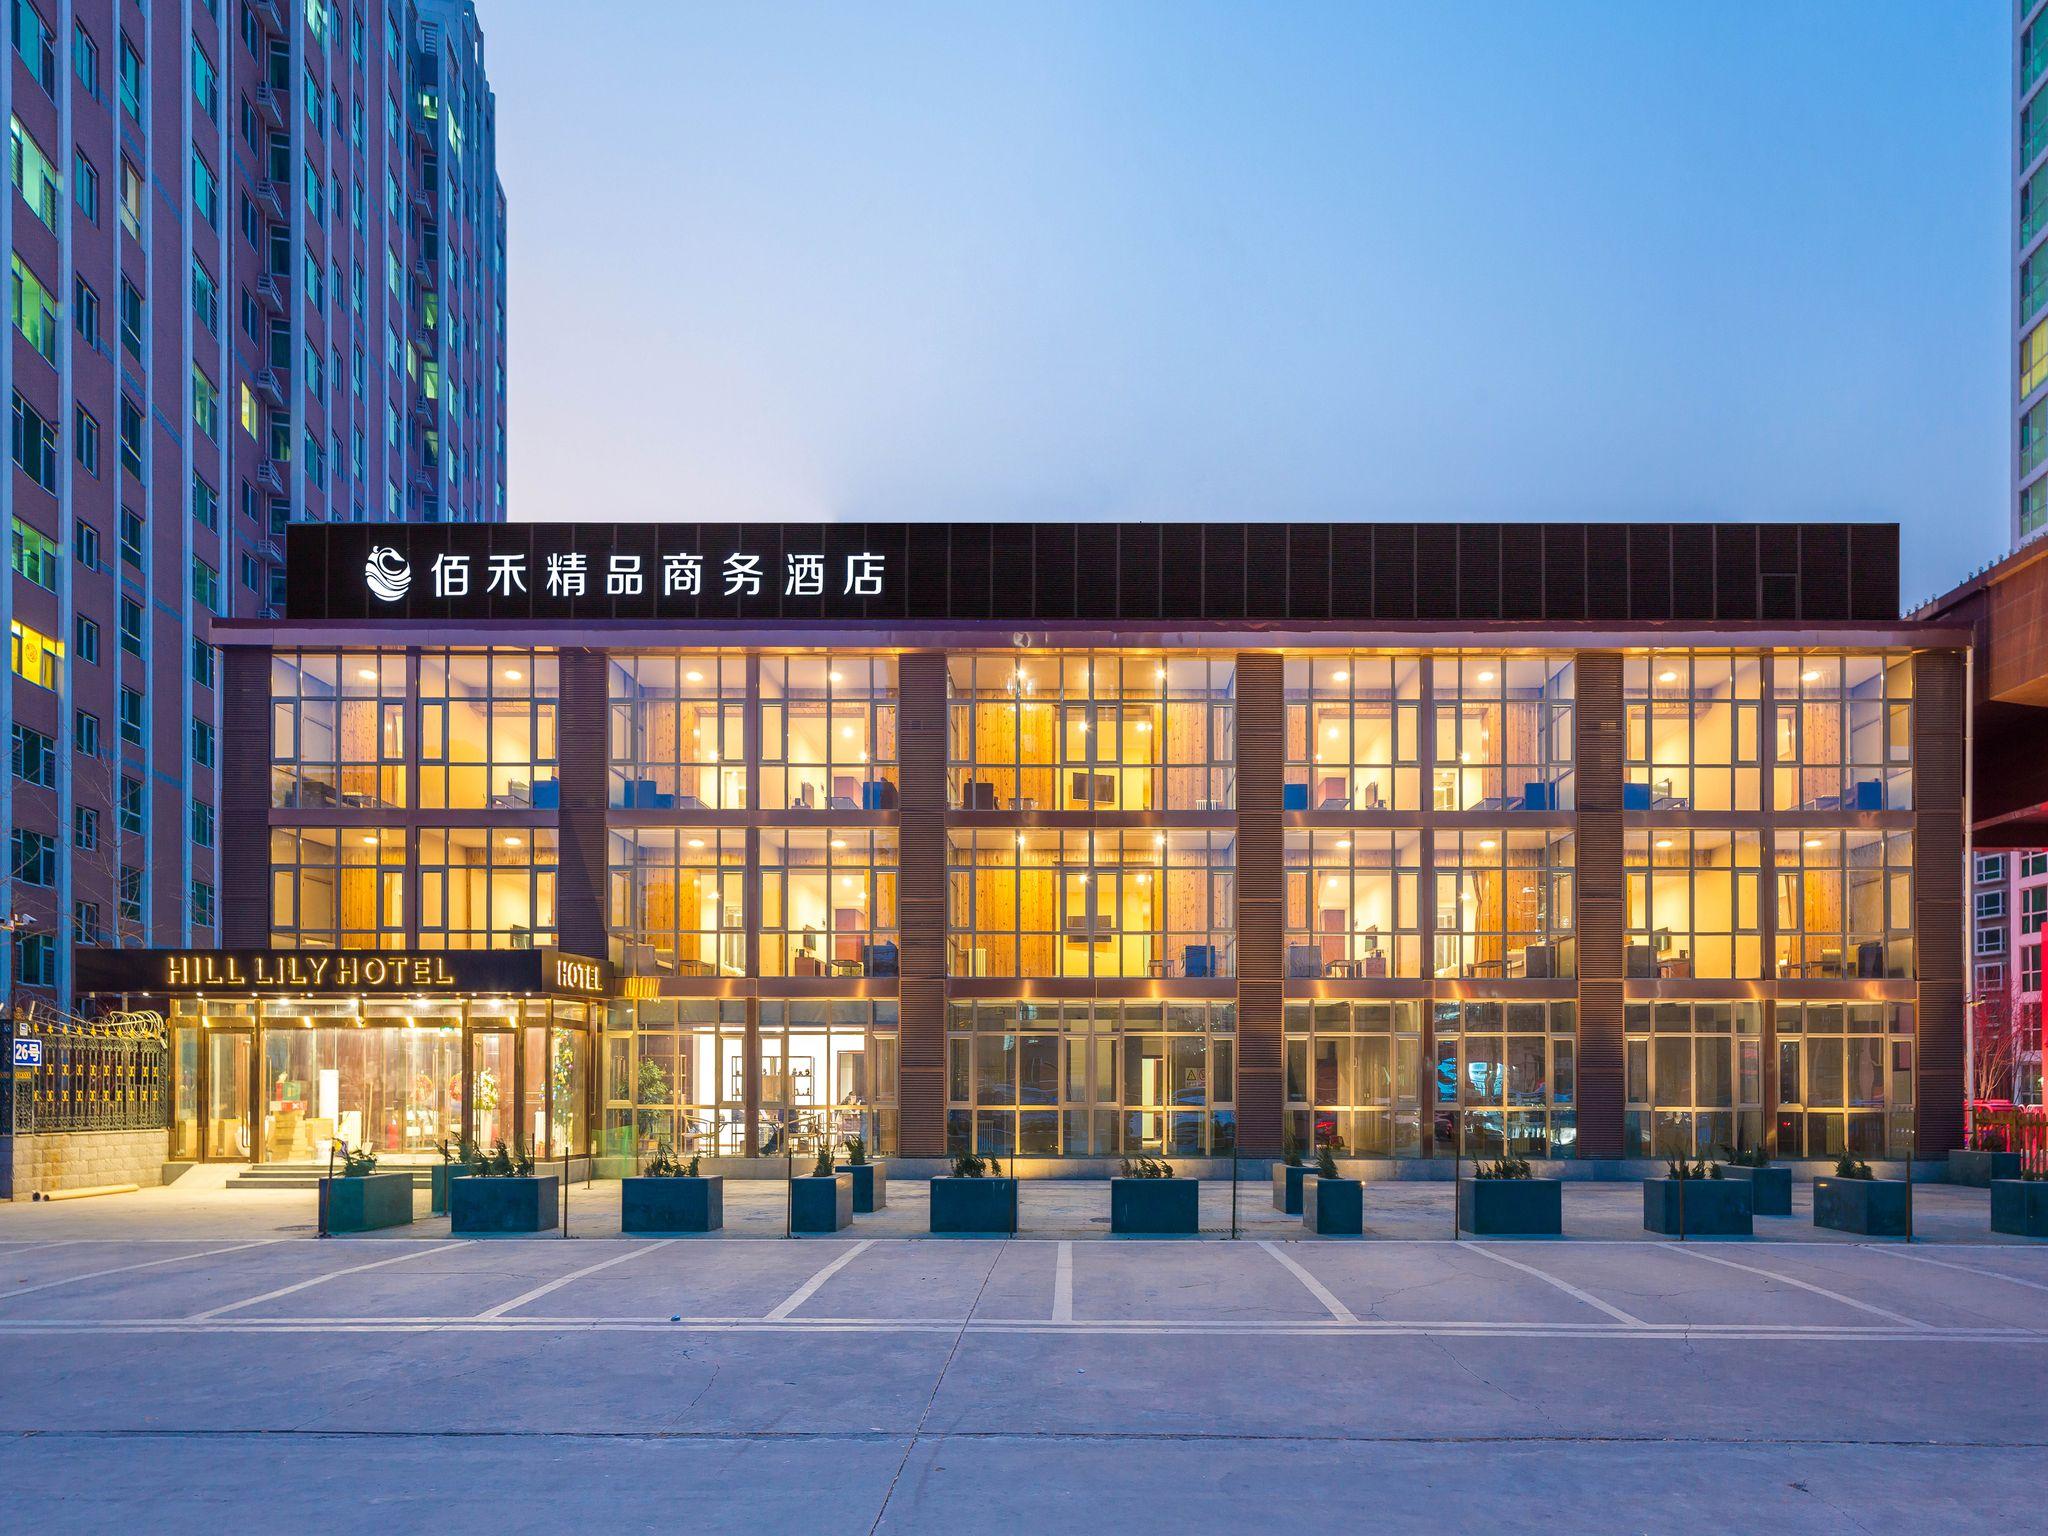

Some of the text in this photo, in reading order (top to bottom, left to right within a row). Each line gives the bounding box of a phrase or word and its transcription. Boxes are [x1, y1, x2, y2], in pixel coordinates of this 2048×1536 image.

[430, 552, 886, 597] 佰禾精品商务酒店
[167, 956, 454, 985] HILL LILY HOTEL
[557, 960, 603, 991] HOTEL
[15, 1043, 40, 1062] 26号
